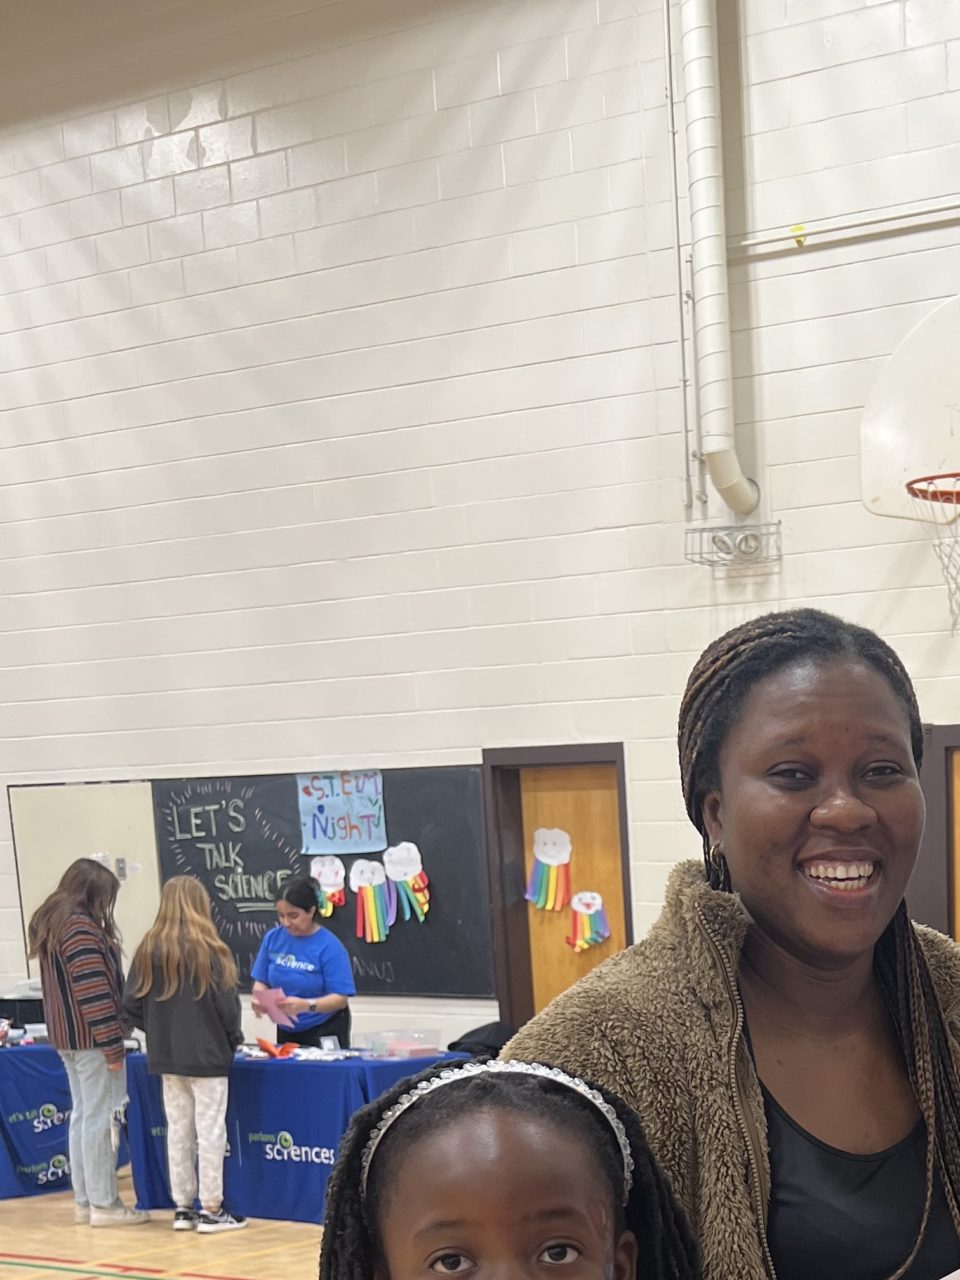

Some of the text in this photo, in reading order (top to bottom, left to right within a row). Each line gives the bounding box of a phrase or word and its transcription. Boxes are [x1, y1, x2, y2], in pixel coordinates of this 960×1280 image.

[173, 799, 246, 840] LET'S
[195, 840, 244, 870] TALK
[264, 1134, 336, 1165] sciences
